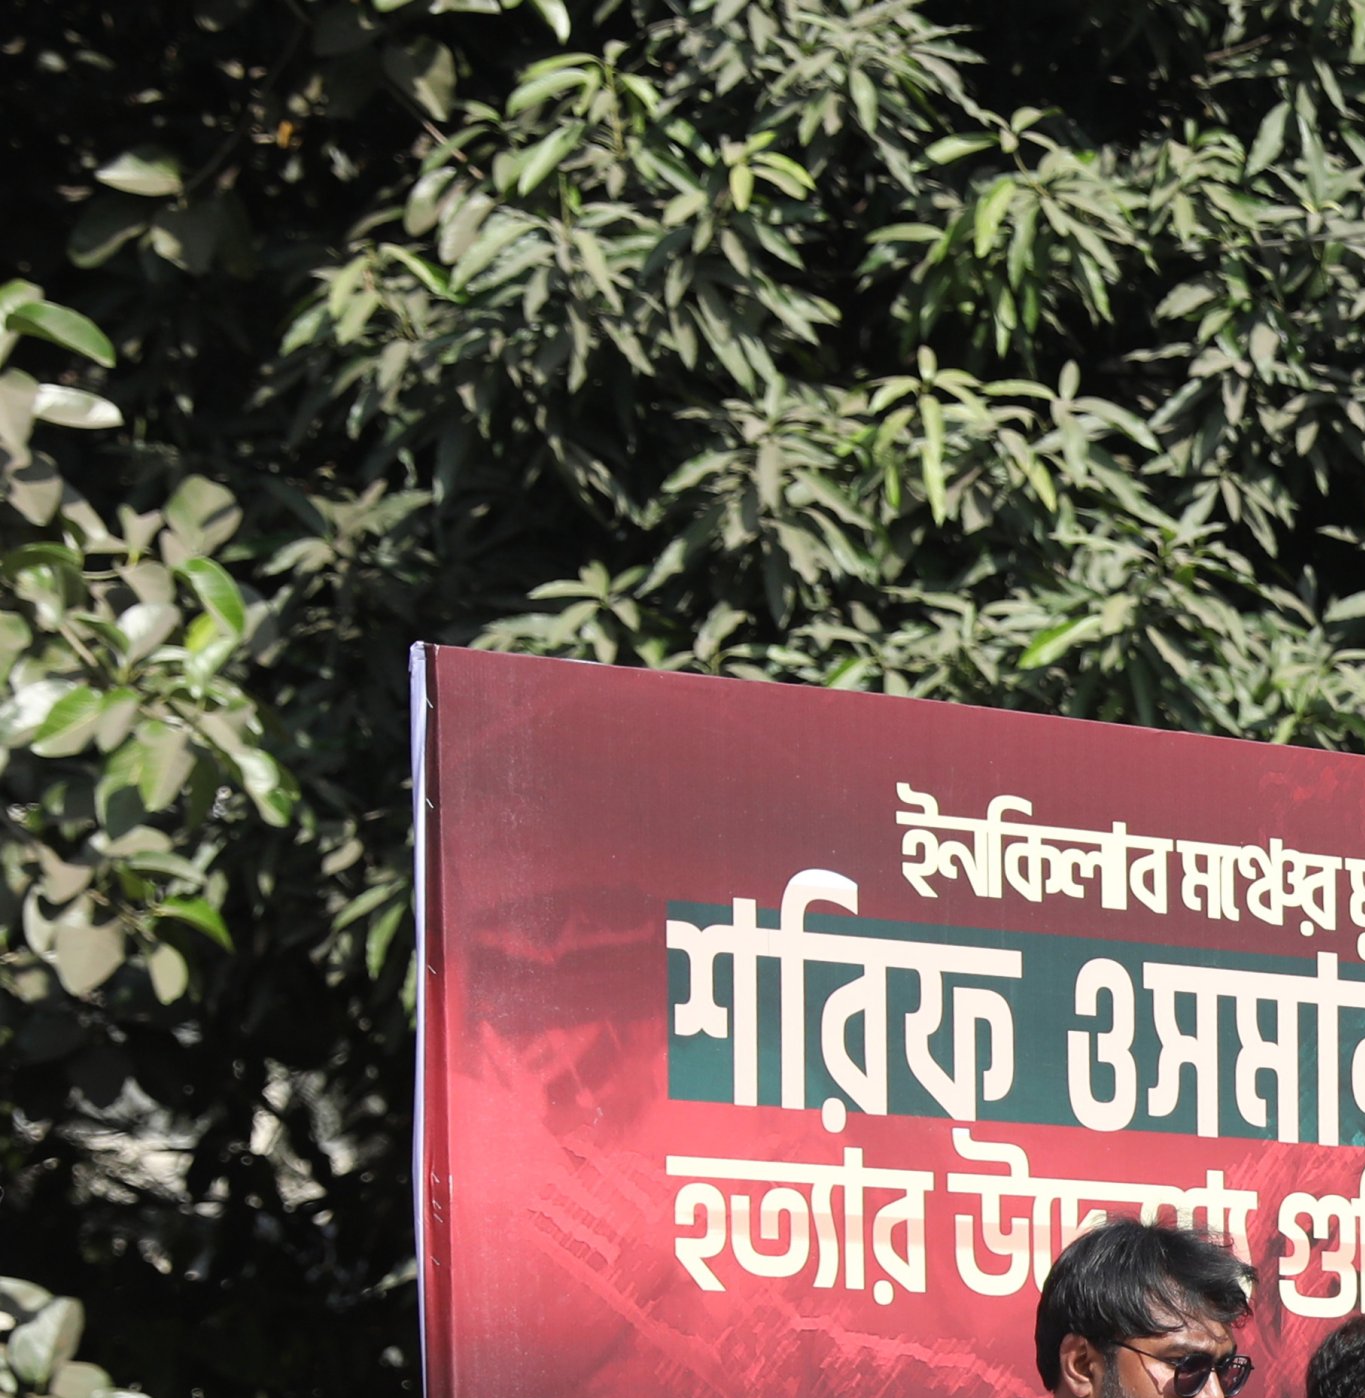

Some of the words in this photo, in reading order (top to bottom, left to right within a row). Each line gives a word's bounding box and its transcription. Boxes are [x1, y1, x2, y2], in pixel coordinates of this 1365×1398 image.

[896, 782, 1174, 916] ইনকিলাব
[1176, 838, 1343, 937] মঞ্চের
[666, 869, 1022, 1133] শরিফ
[666, 1147, 934, 1306] হত্যার
